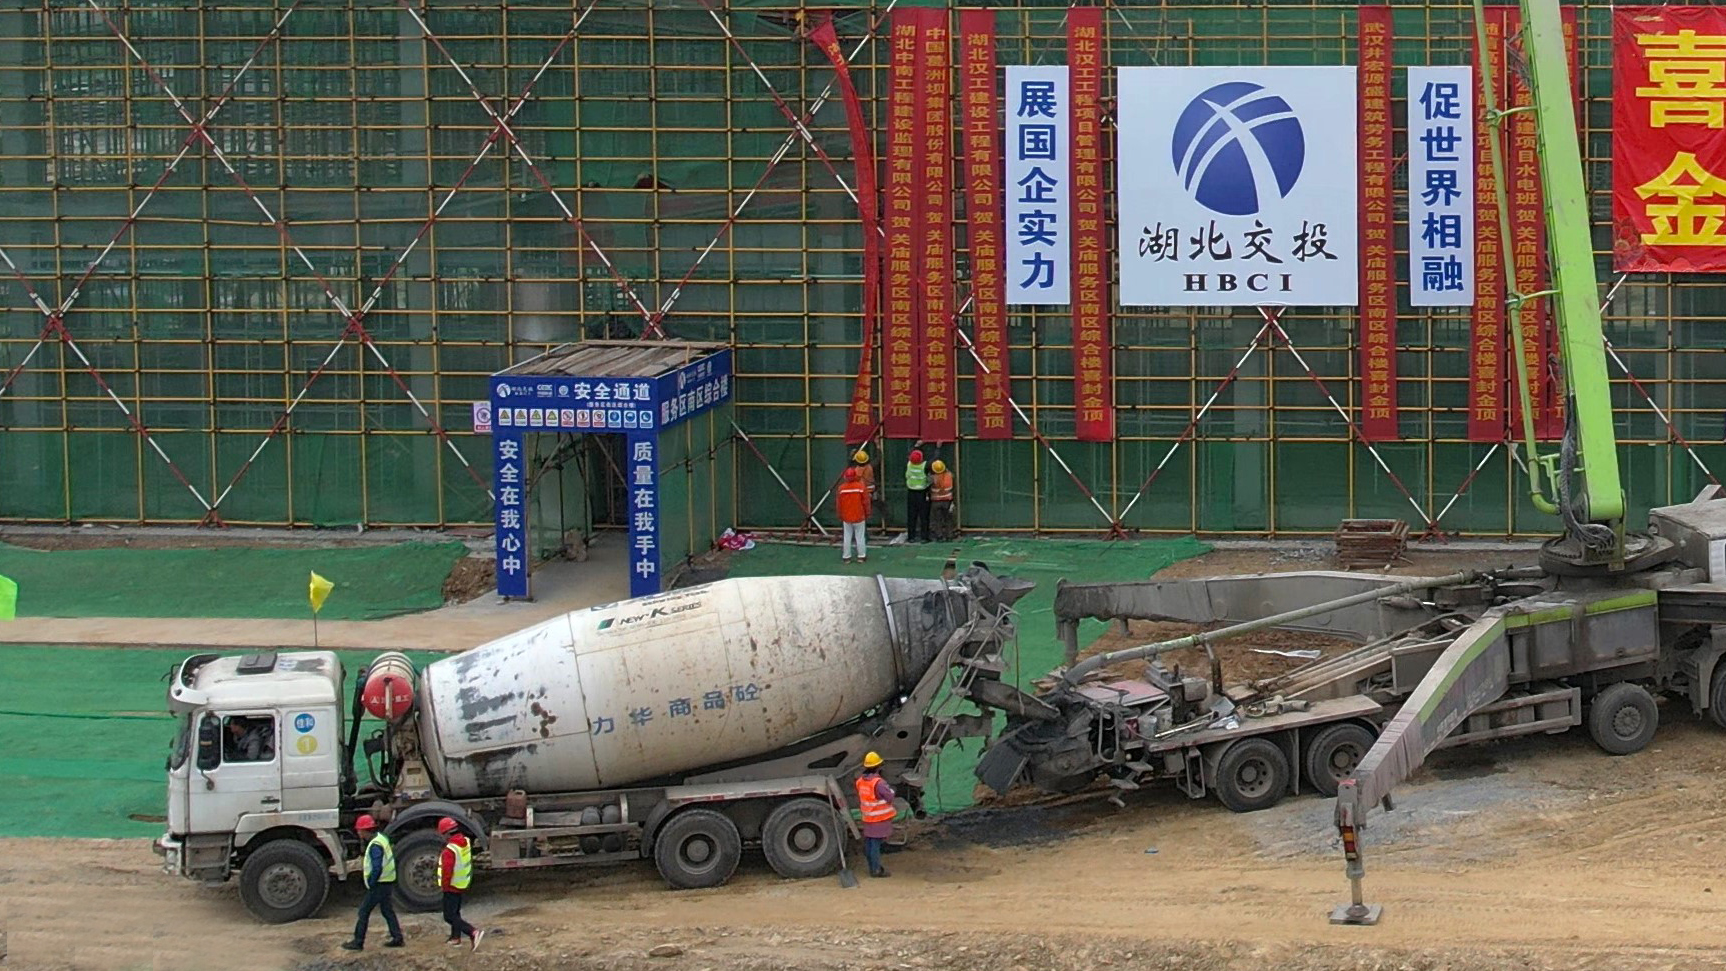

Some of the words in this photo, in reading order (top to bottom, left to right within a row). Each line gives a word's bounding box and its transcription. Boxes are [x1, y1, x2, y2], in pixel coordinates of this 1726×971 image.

[1016, 80, 1059, 289] 展国企实力
[1418, 81, 1465, 292] 促世界相融
[891, 215, 912, 229] 贺
[925, 211, 944, 225] 贺
[973, 211, 995, 225] 贺
[1076, 217, 1098, 231] 贺
[1477, 209, 1499, 223] 贺
[1516, 209, 1538, 223] 贺
[1138, 219, 1339, 264] 湖北交投
[1365, 228, 1386, 241] 贺
[1182, 273, 1292, 292] HBCI
[574, 382, 651, 401] 安全通道
[499, 440, 521, 576] 安全在我心中
[633, 441, 655, 579] 质量在我手中
[593, 683, 760, 736] 力华商品砼
